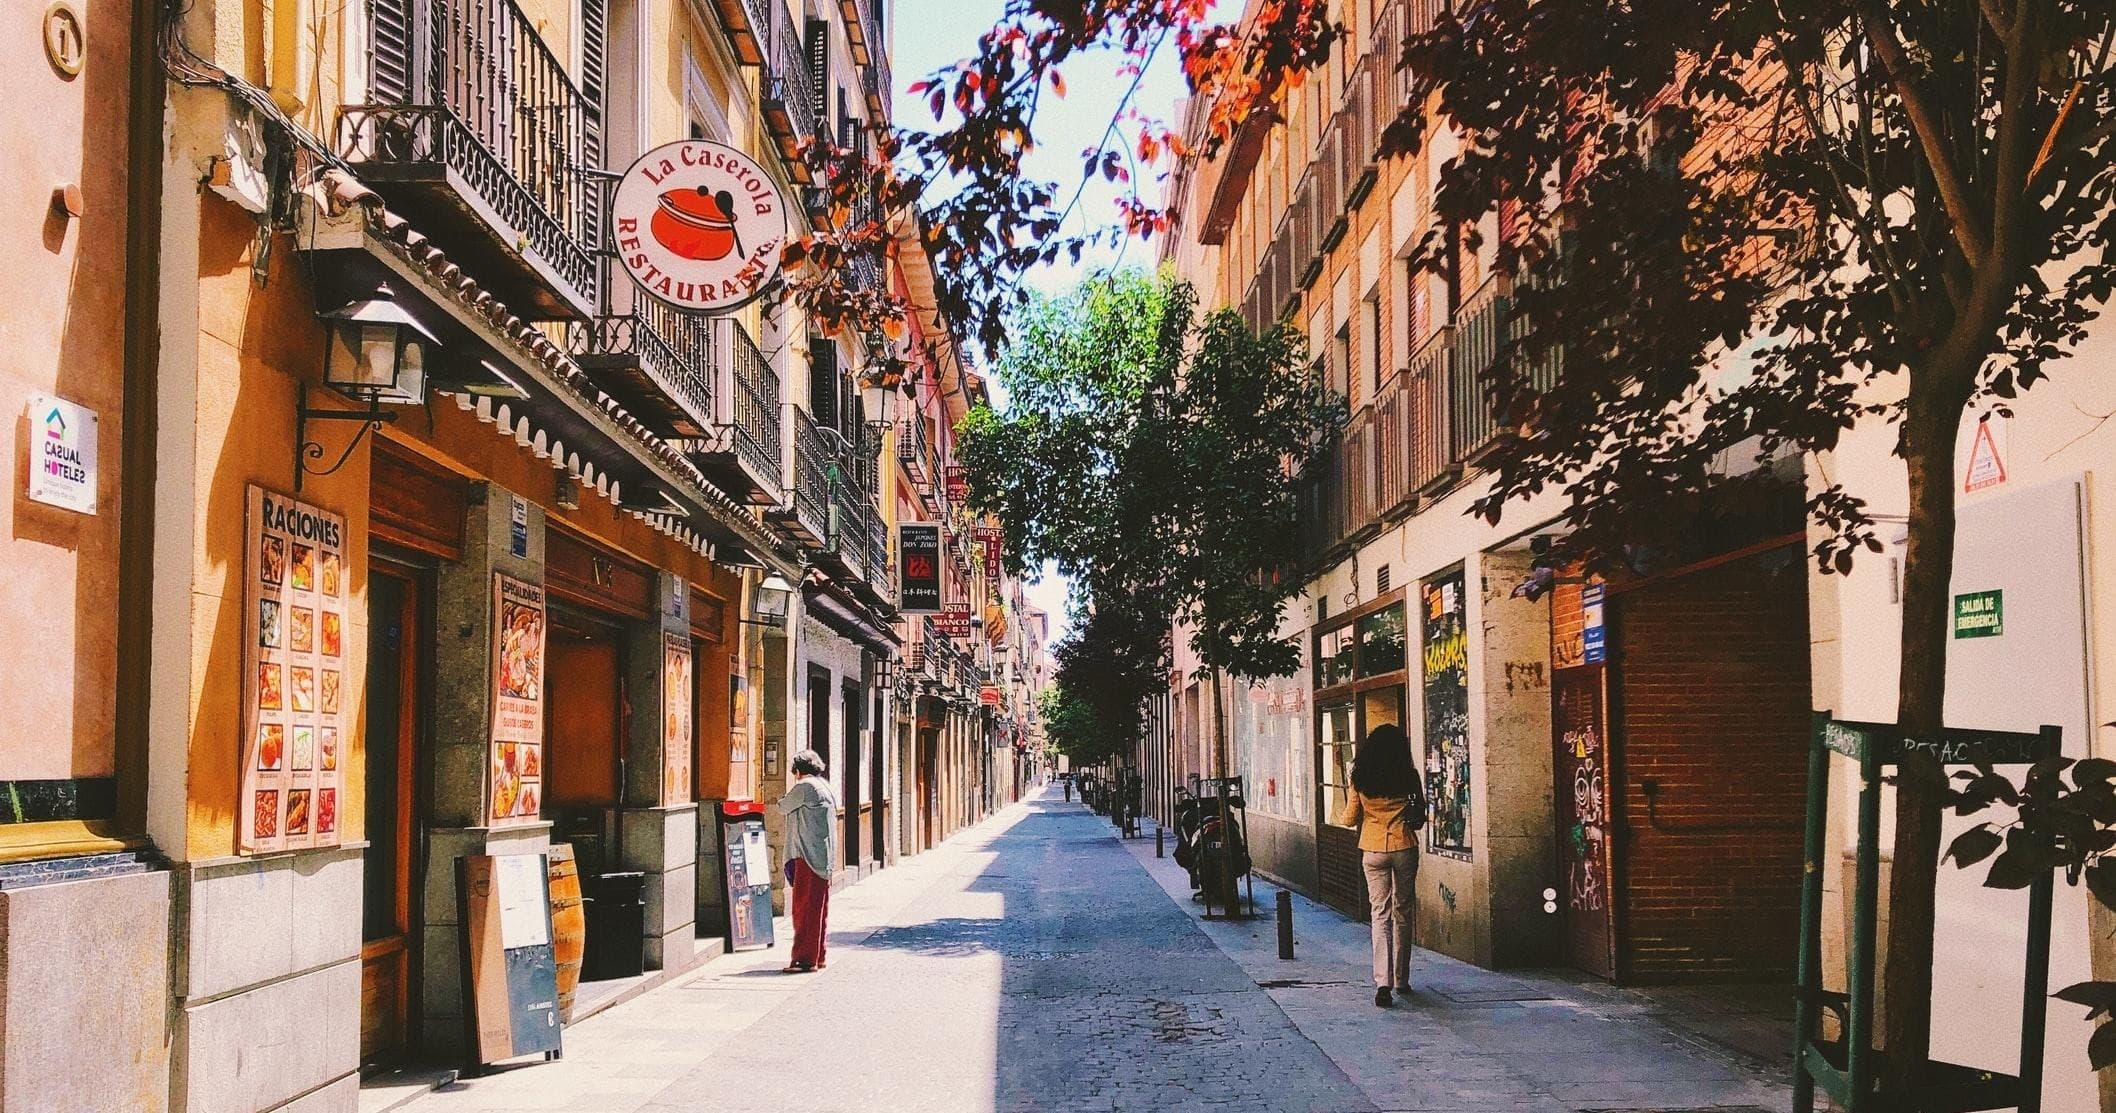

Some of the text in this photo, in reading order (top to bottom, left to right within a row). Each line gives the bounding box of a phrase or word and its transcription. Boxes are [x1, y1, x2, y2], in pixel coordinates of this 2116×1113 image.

[641, 145, 773, 217] La Caserola
[44, 440, 81, 466] CASUAL
[44, 458, 86, 484] HOTELES
[262, 497, 340, 548] RACIONES
[989, 542, 997, 576] LIDO
[943, 604, 969, 613] OSTAL
[1960, 597, 1994, 613] SALIDA DE
[1957, 612, 1999, 630] EMERGENCIA
